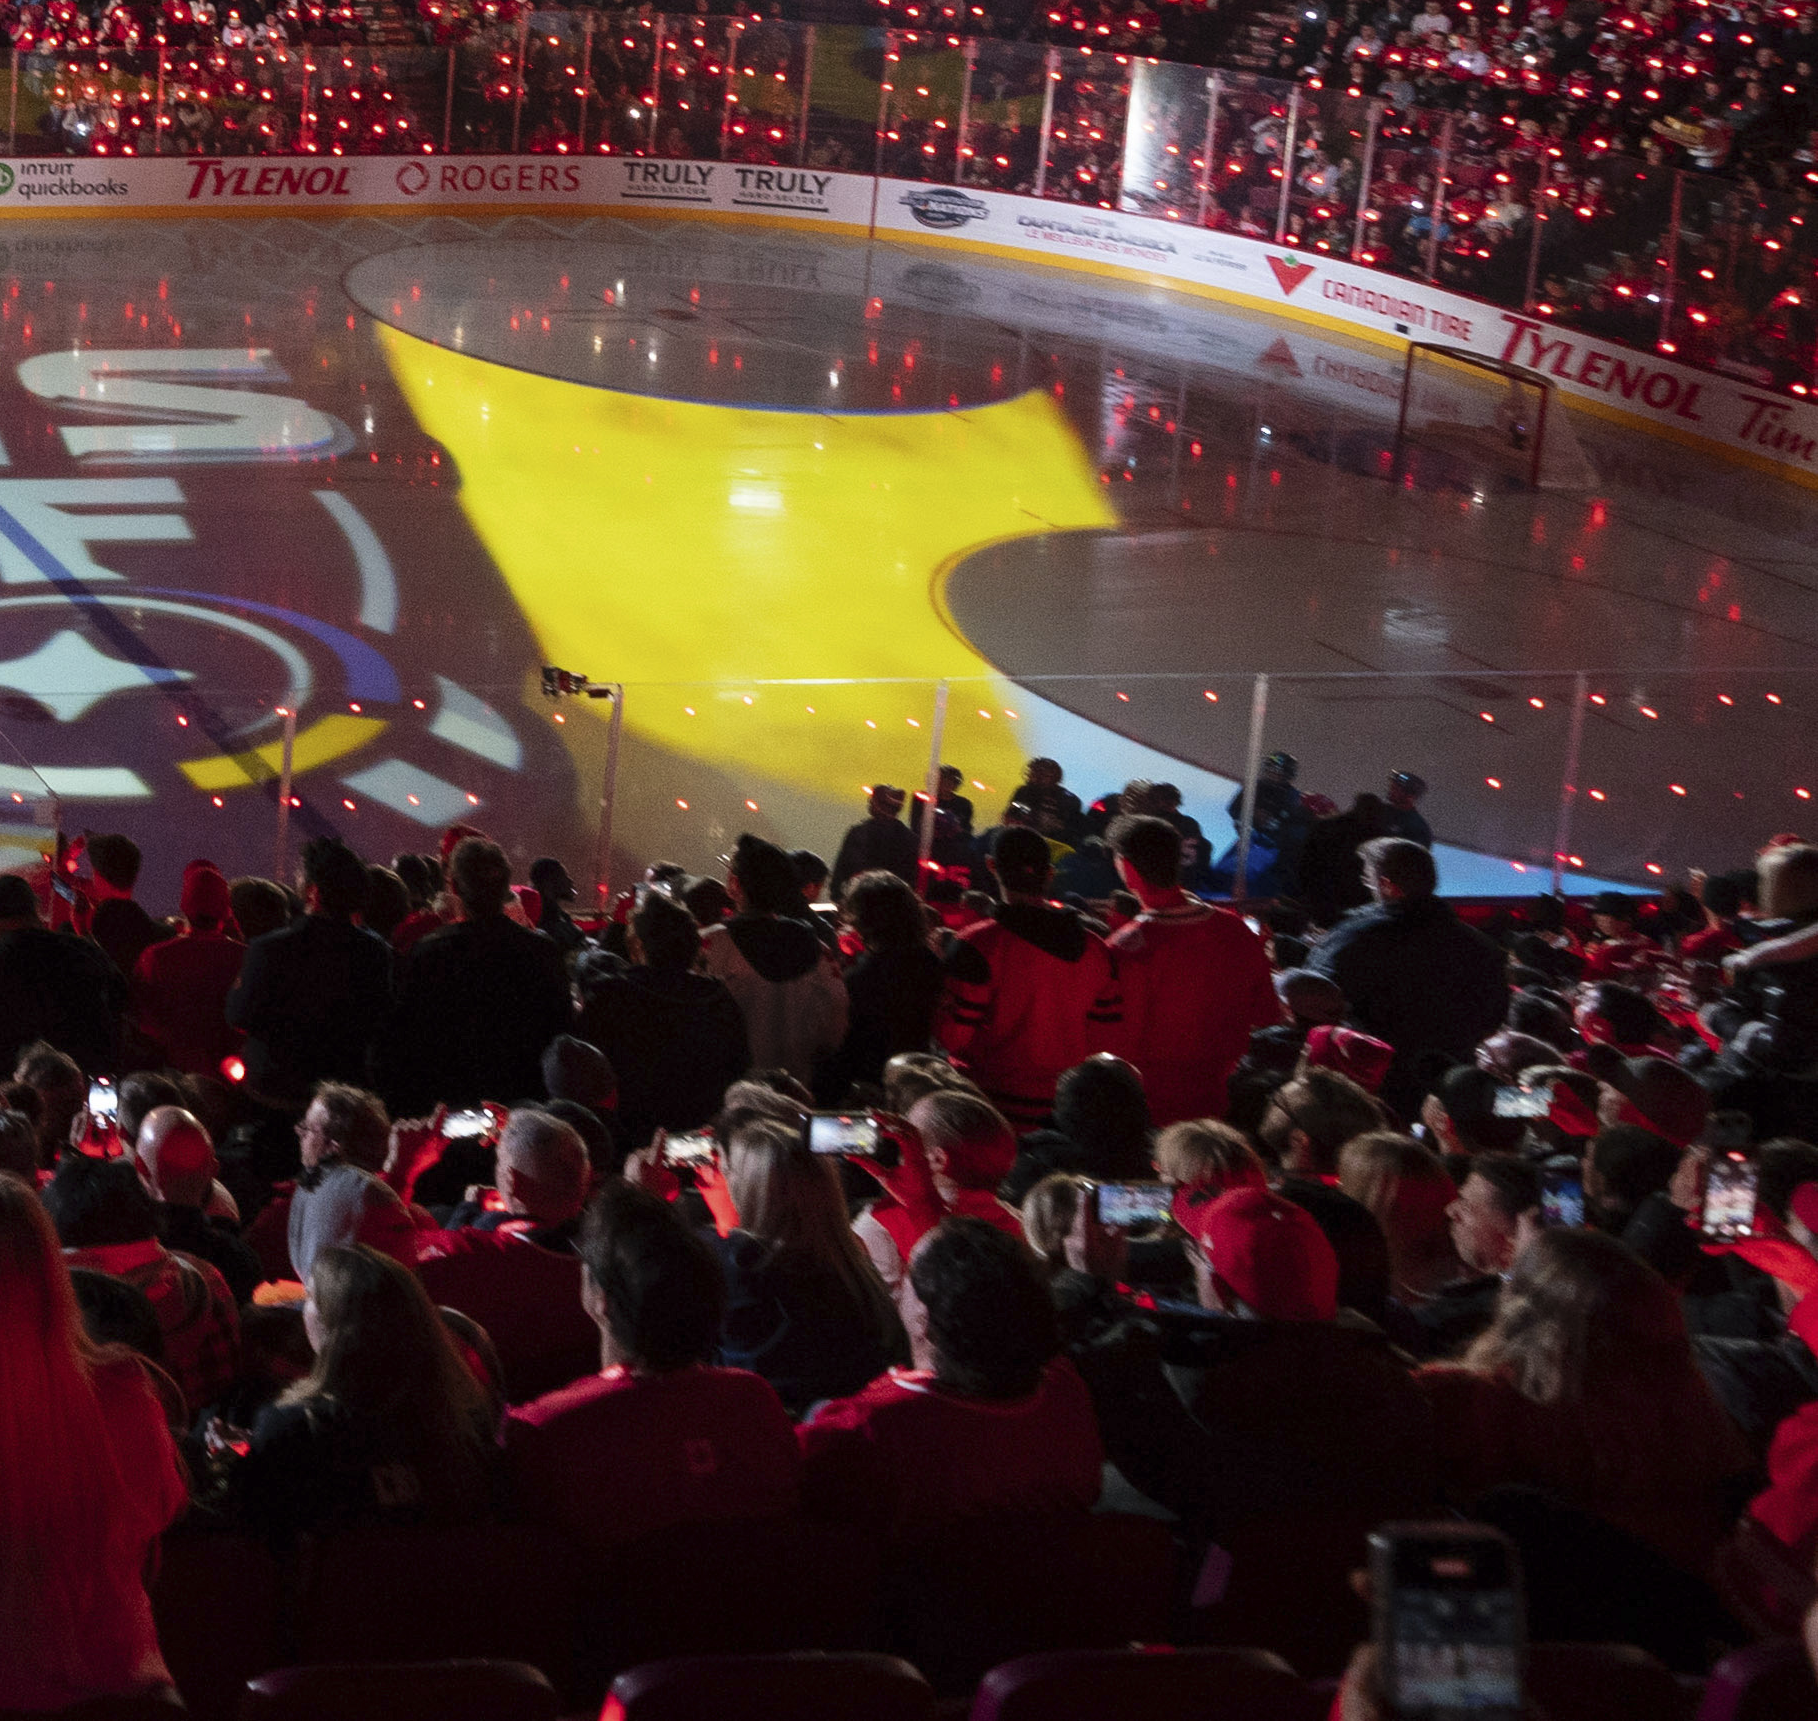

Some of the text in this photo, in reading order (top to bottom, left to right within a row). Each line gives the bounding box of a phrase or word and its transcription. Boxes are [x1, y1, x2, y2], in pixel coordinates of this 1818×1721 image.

[20, 162, 75, 176] INTUIT
[187, 158, 353, 200] TYLENOL
[440, 164, 580, 192] ROGERS
[623, 161, 714, 185] TRULY
[736, 168, 832, 196] TRULY
[18, 178, 129, 199] quickbooks
[1321, 278, 1471, 342] CANADIAN TIRE
[1500, 313, 1703, 423] TYLENOL
